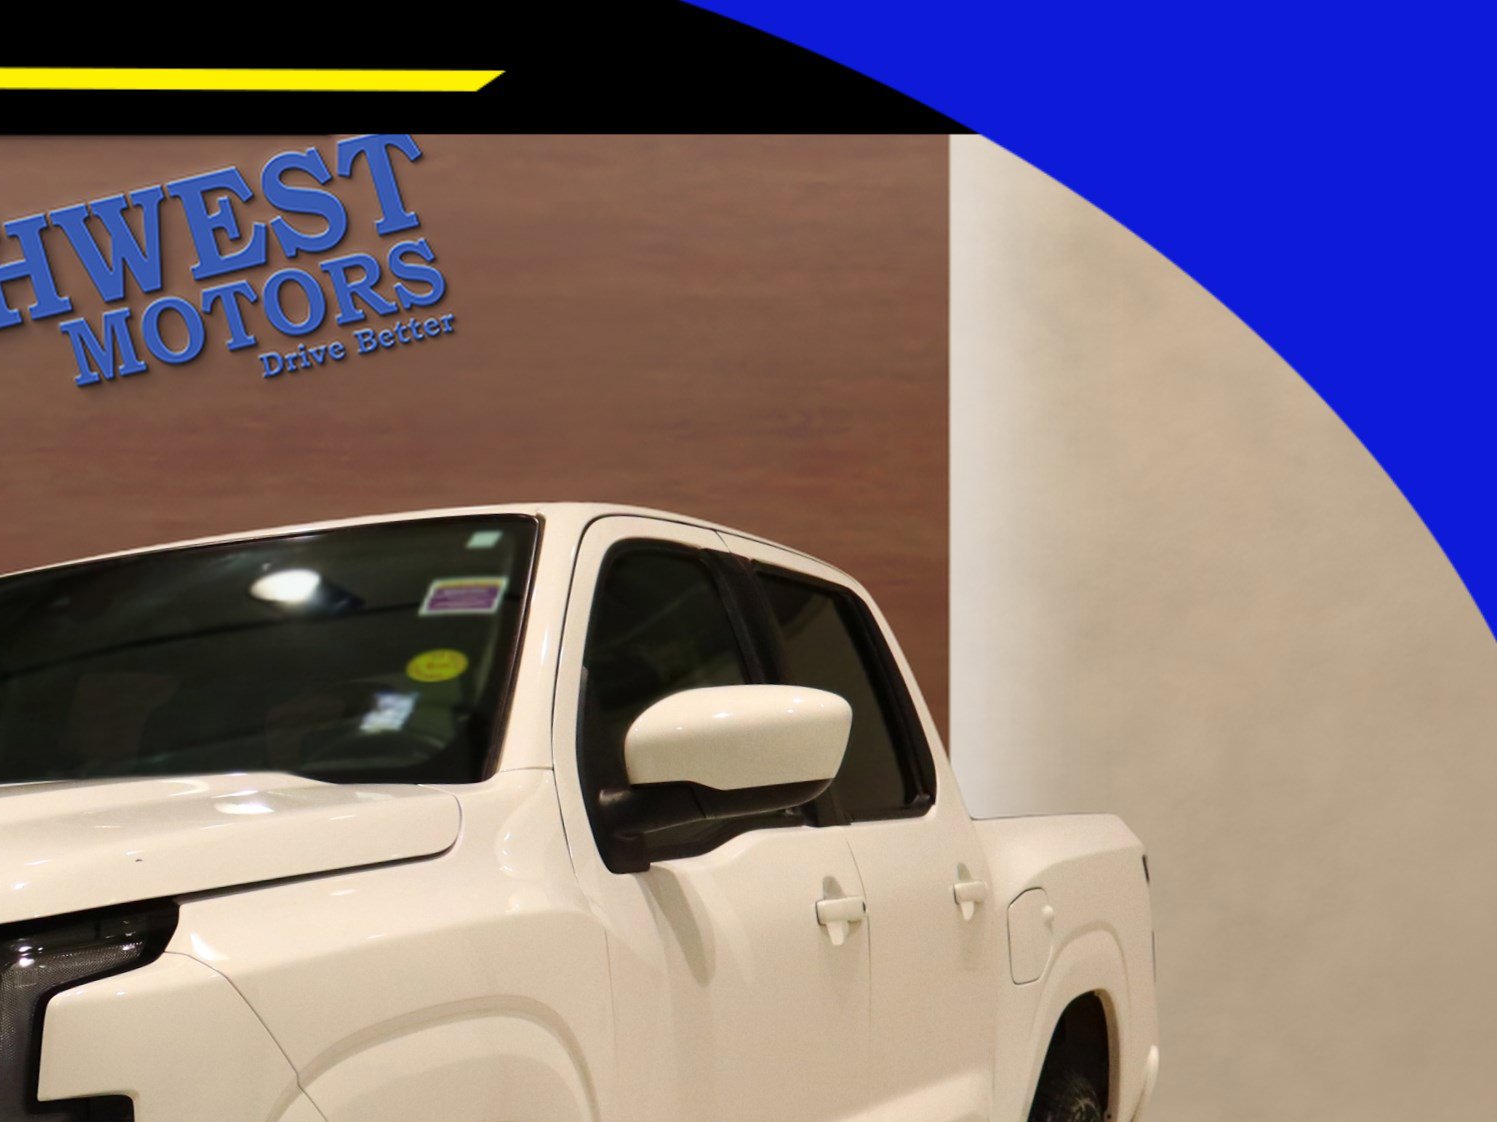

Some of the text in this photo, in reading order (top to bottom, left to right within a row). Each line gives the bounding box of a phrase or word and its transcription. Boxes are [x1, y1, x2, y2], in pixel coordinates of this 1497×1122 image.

[59, 239, 445, 386] MOTORS
[259, 313, 455, 378] Drive Better
